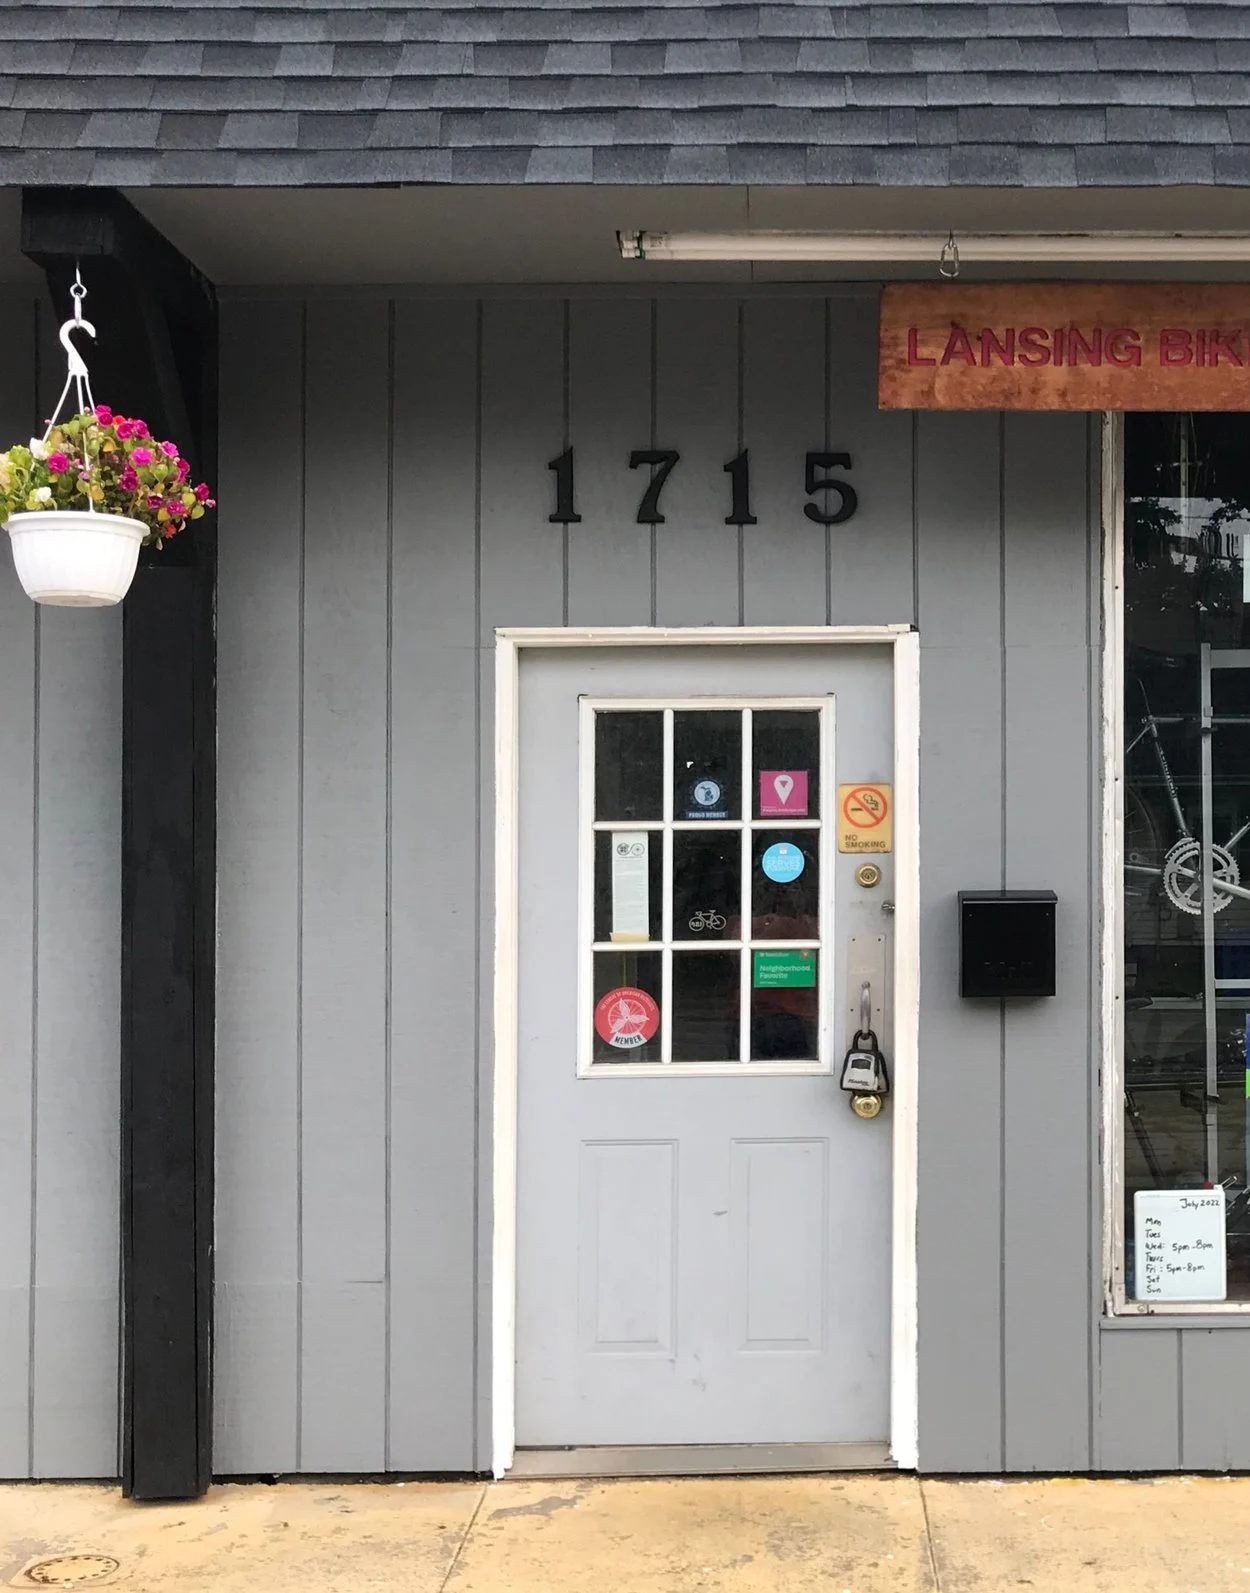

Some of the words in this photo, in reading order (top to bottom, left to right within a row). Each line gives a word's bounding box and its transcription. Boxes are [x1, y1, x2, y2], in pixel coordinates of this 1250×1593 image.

[907, 327, 1143, 369] LANSING
[548, 446, 858, 525] 1715
[845, 841, 886, 849] SMOKING
[760, 965, 811, 973] Neighborhood
[615, 1034, 643, 1045] MEMBER
[1179, 1198, 1199, 1210] July
[1200, 1199, 1220, 1207] 2022
[1145, 1217, 1162, 1226] Mon
[1145, 1229, 1161, 1238] Tues
[1146, 1275, 1160, 1283] Sat
[1146, 1285, 1162, 1294] Sun
